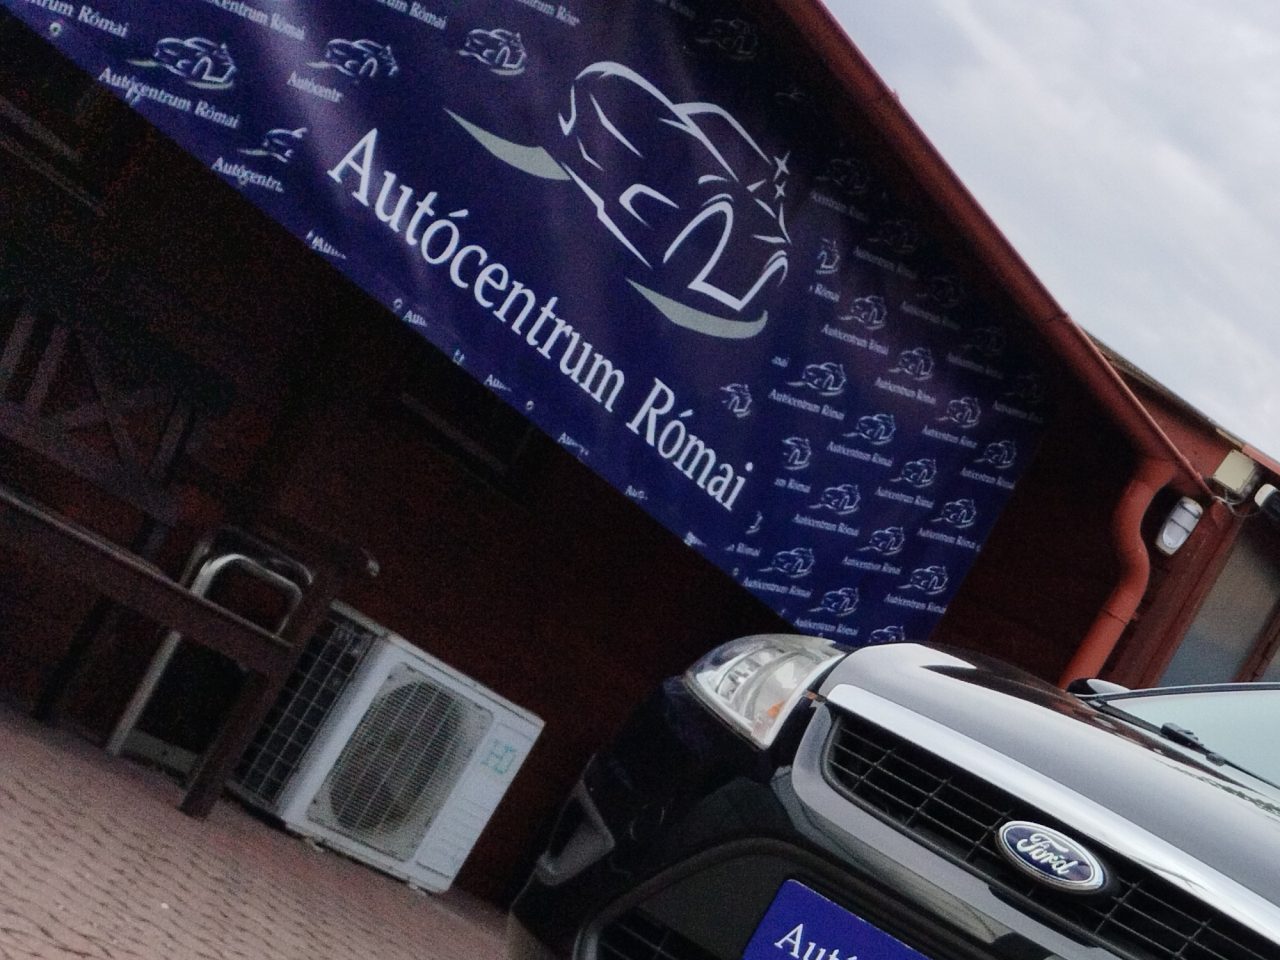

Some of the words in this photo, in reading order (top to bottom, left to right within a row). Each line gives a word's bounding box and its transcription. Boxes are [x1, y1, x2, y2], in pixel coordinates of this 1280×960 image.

[327, 127, 625, 412] Autócentrum
[625, 376, 754, 511] Római
[1017, 833, 1078, 875] Ford
